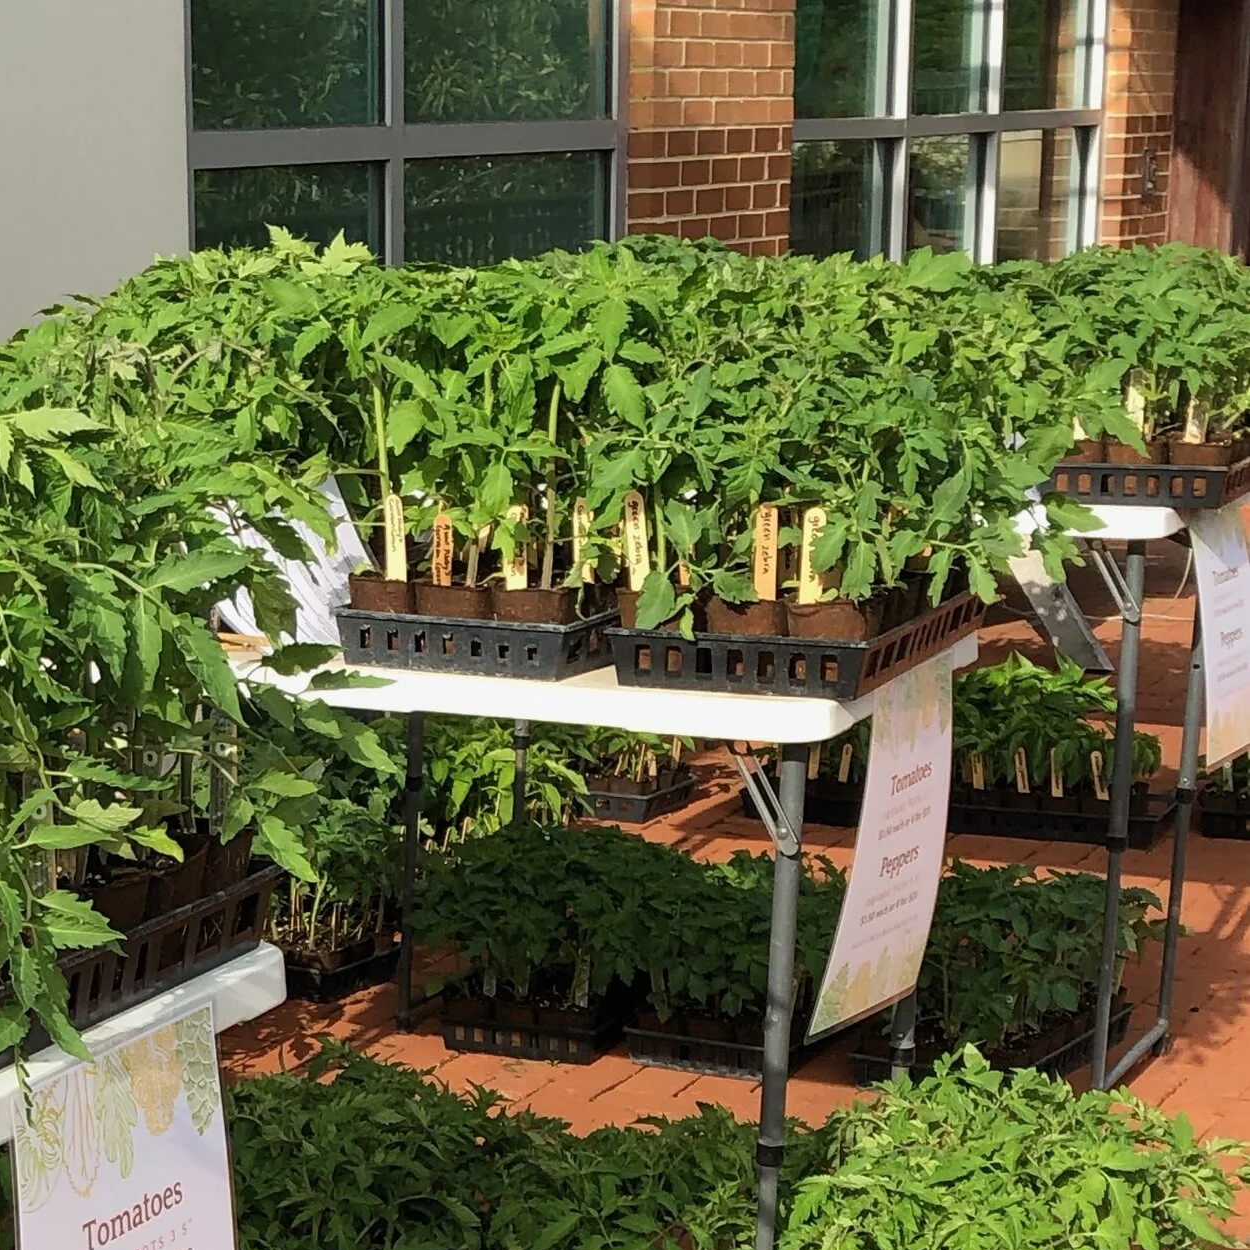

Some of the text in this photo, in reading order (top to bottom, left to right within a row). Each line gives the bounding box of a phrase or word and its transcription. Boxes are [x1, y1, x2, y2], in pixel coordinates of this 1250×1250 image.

[627, 500, 643, 565] green zebra
[761, 511, 773, 574] green zebra
[890, 761, 933, 797] Tomatoes
[879, 845, 920, 879] Peppers
